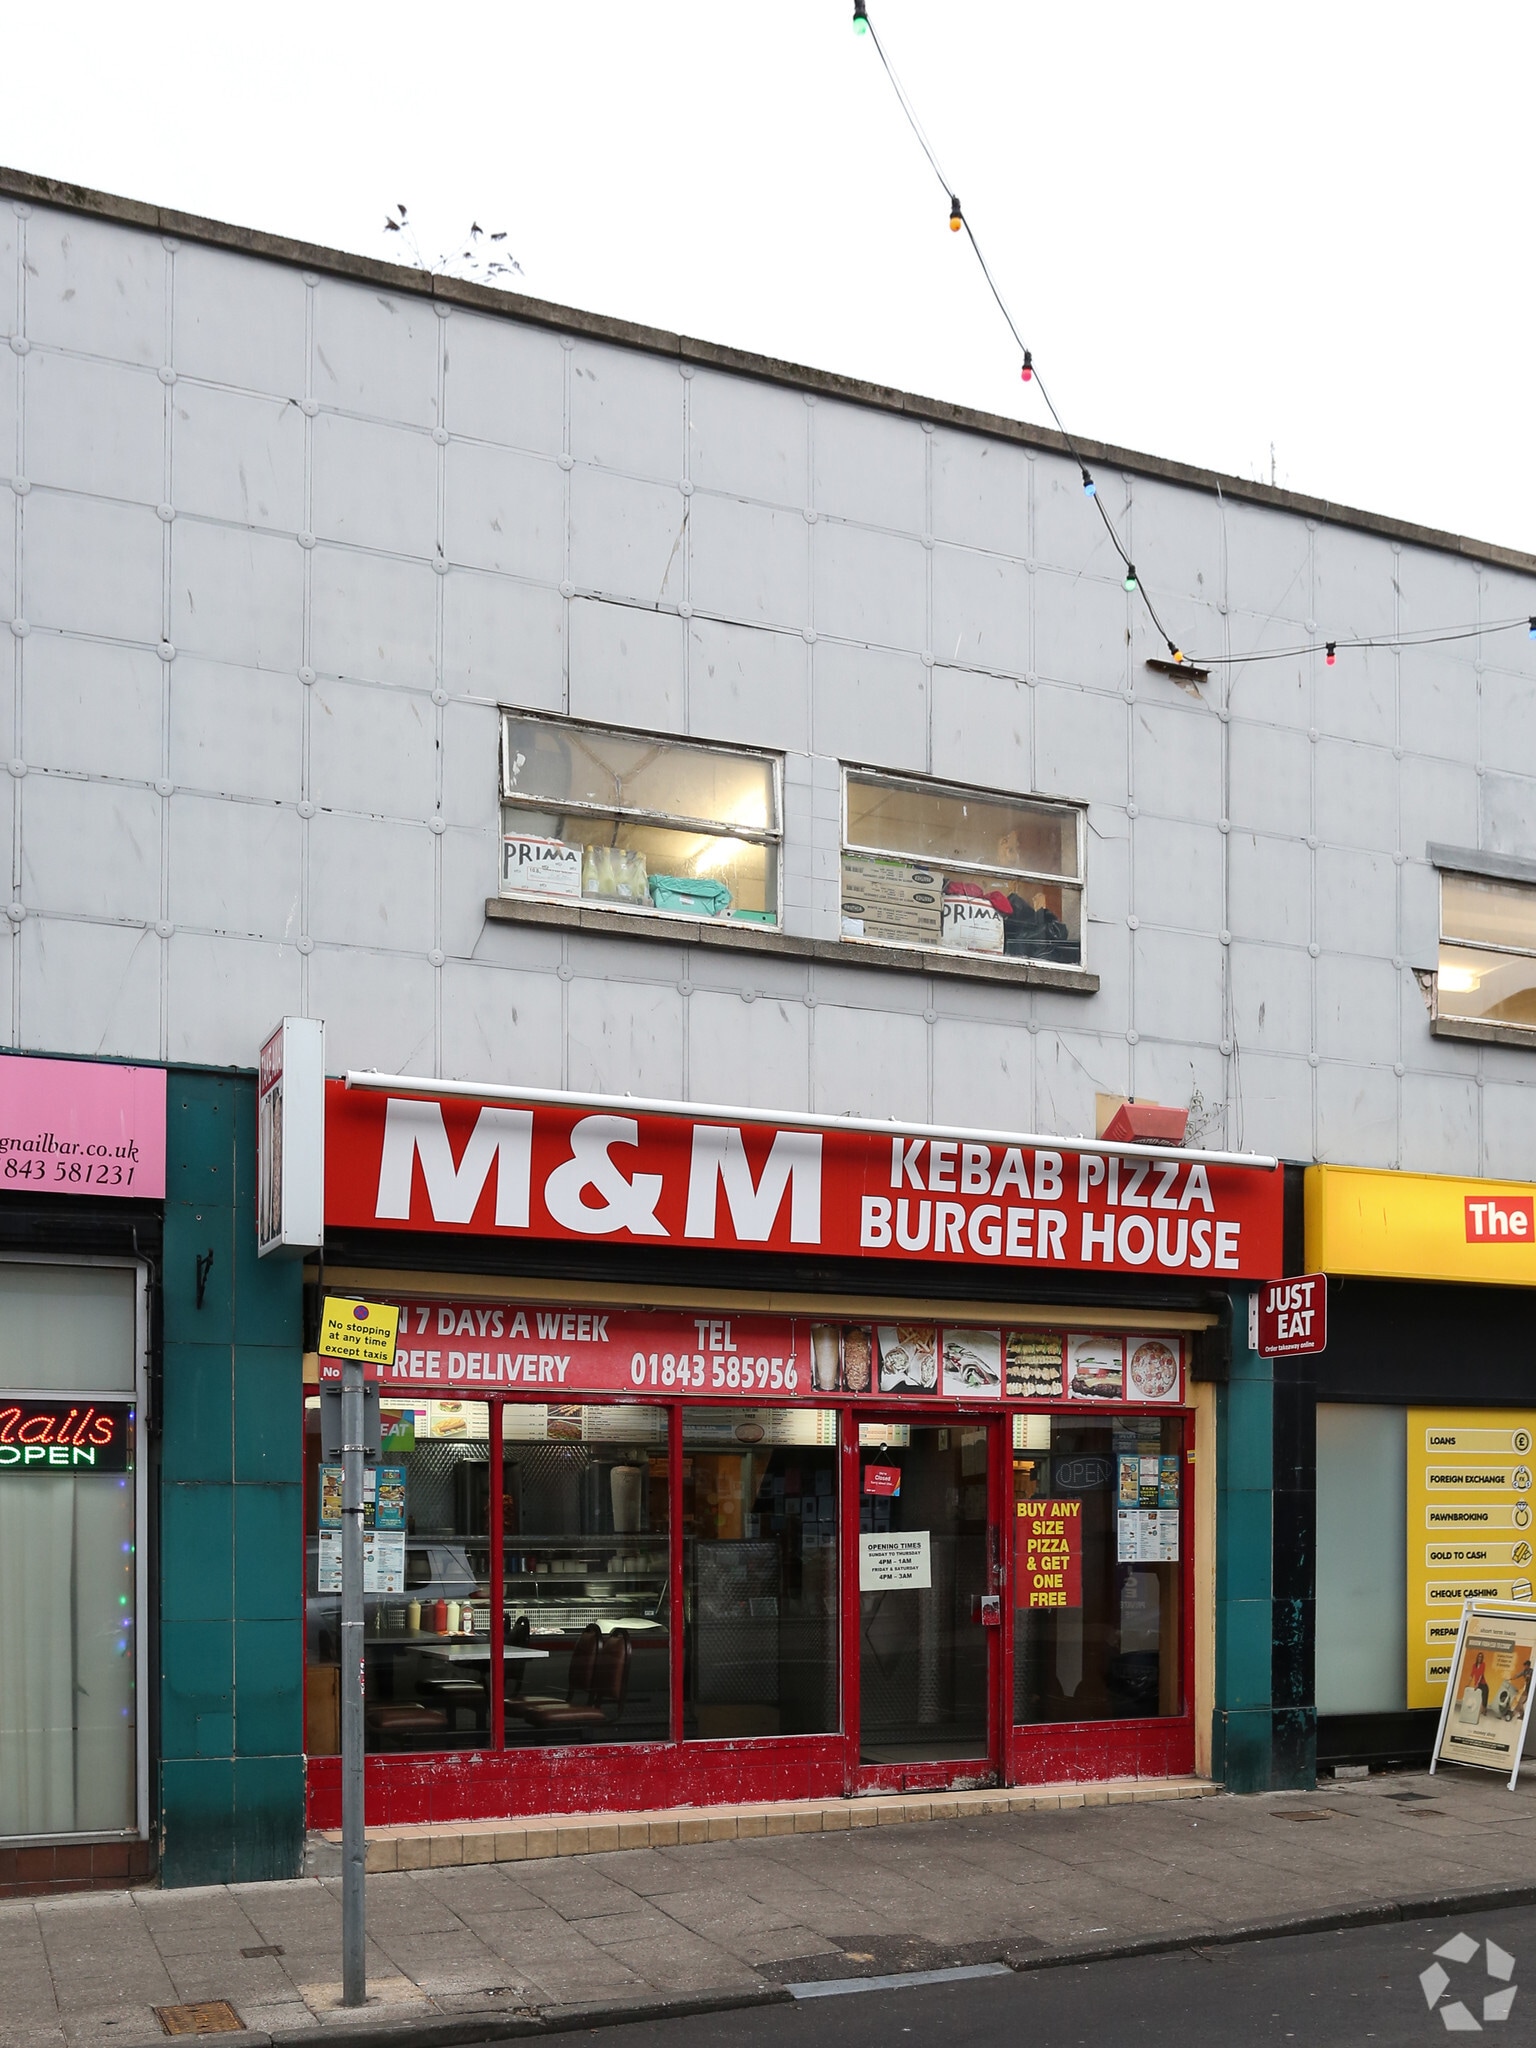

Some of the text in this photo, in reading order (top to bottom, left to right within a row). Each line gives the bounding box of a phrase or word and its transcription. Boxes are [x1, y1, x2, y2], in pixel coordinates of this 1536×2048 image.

[503, 842, 577, 879] PRIMA
[0, 1158, 135, 1186] 843 581231
[375, 1097, 823, 1244] M&M
[890, 1137, 1216, 1213] KEBAB PIZZA
[1469, 1201, 1528, 1235] The
[860, 1195, 1240, 1270] BURGER HOUSE
[1265, 1281, 1315, 1313] JUST
[328, 1319, 391, 1338] No stopping
[415, 1307, 430, 1334] 7
[437, 1308, 505, 1339] DAYS
[510, 1311, 530, 1339] A
[535, 1312, 610, 1343] WEEK
[1278, 1310, 1315, 1339] EAT
[329, 1331, 387, 1347] at any time
[694, 1319, 737, 1352] TEL
[325, 1345, 388, 1361] except taxis
[1265, 1345, 1278, 1353] Order
[1278, 1342, 1300, 1352] takeaway
[323, 1366, 340, 1377] No
[447, 1351, 571, 1383] DELIVERY
[631, 1352, 798, 1390] 01843 585956
[380, 1423, 409, 1437] EAT
[1430, 1437, 1456, 1445] LOANS
[1060, 1463, 1108, 1483] OPEN
[1430, 1475, 1463, 1484] FOREIGN
[1465, 1475, 1505, 1484] EXCHANGE
[1017, 1502, 1080, 1517] BUY ANY
[1430, 1513, 1488, 1521] PAWNBROKING
[1032, 1520, 1064, 1535] SIZE
[1027, 1539, 1070, 1553] PIZZA
[1026, 1555, 1070, 1571] & GET
[1430, 1552, 1452, 1560] GOLD
[1466, 1551, 1487, 1559] CASH
[1033, 1573, 1064, 1588] ONE
[1029, 1591, 1067, 1607] FREE
[1430, 1588, 1498, 1598] CHEQUE CASHING
[1430, 1666, 1451, 1675] MON
